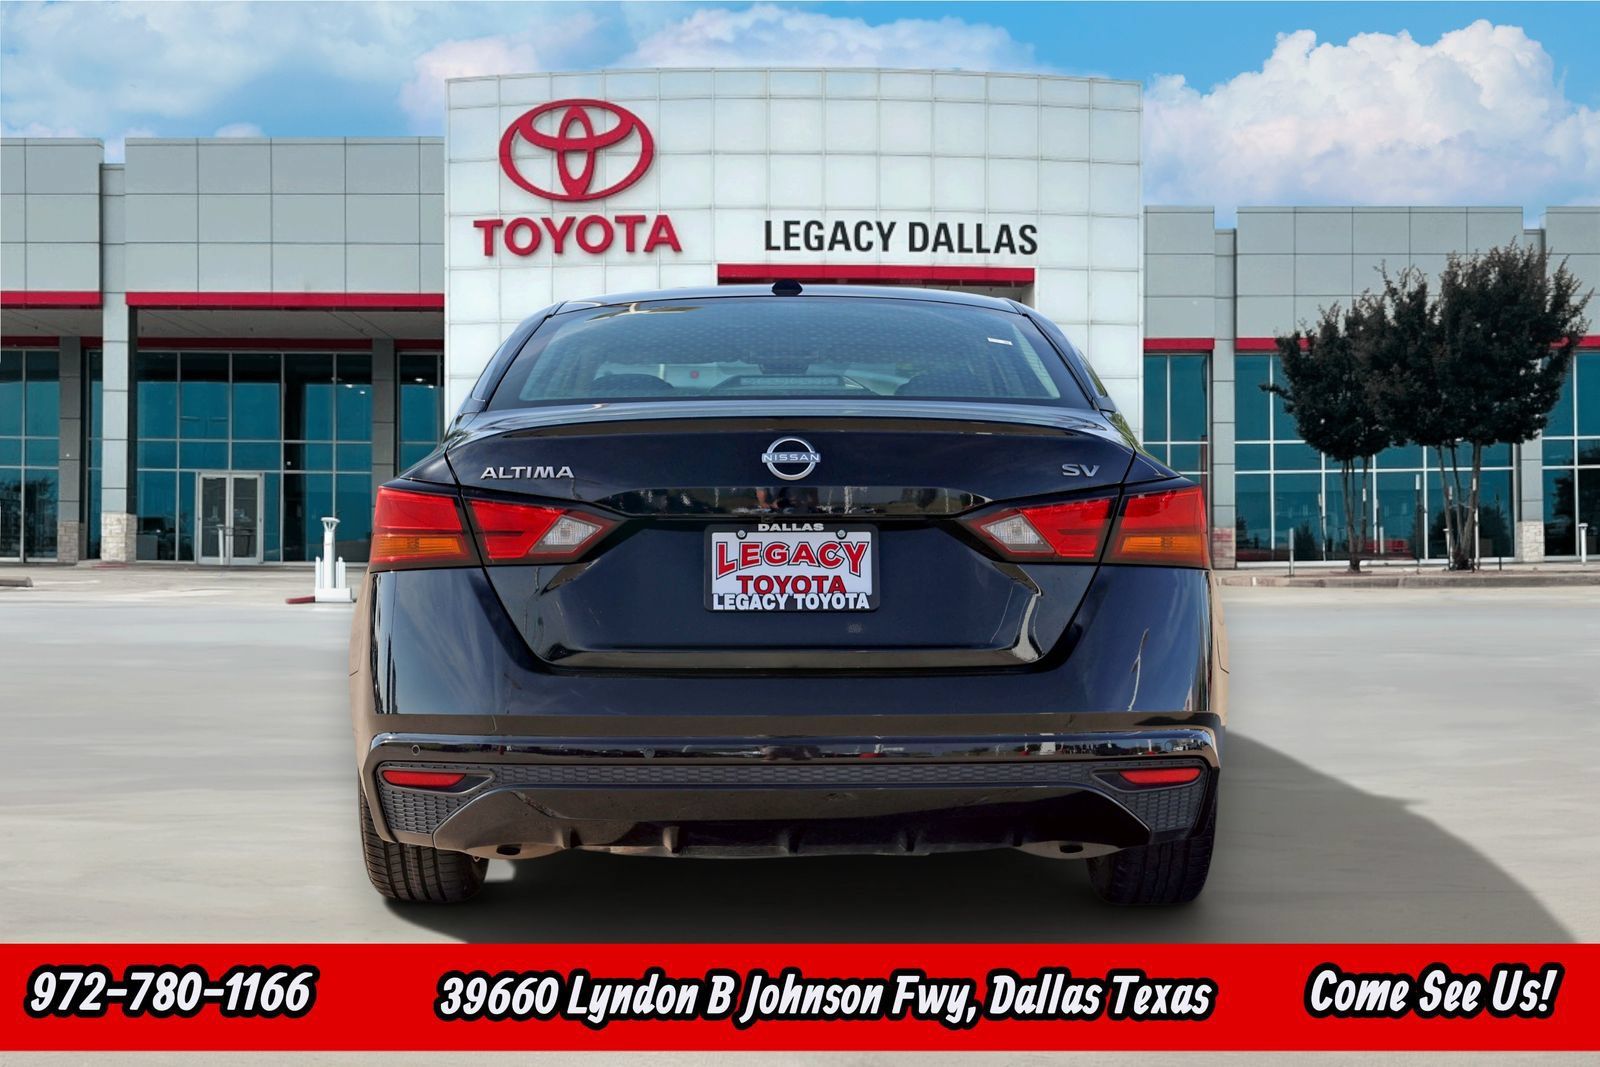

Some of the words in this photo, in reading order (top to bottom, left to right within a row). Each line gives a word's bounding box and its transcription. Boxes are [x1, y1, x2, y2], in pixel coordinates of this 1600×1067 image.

[473, 214, 683, 257] TOYOTA
[764, 219, 897, 252] LEGACY
[908, 221, 1038, 255] DALLAS
[761, 453, 821, 462] NISSAN
[480, 466, 575, 479] ALTIMA
[1061, 463, 1101, 477] SV
[757, 522, 825, 532] DALLAS
[715, 541, 870, 580] LEGACY
[736, 575, 848, 594] TOYOTA
[712, 593, 789, 611] LEGACY
[794, 592, 871, 610] TOYOTA
